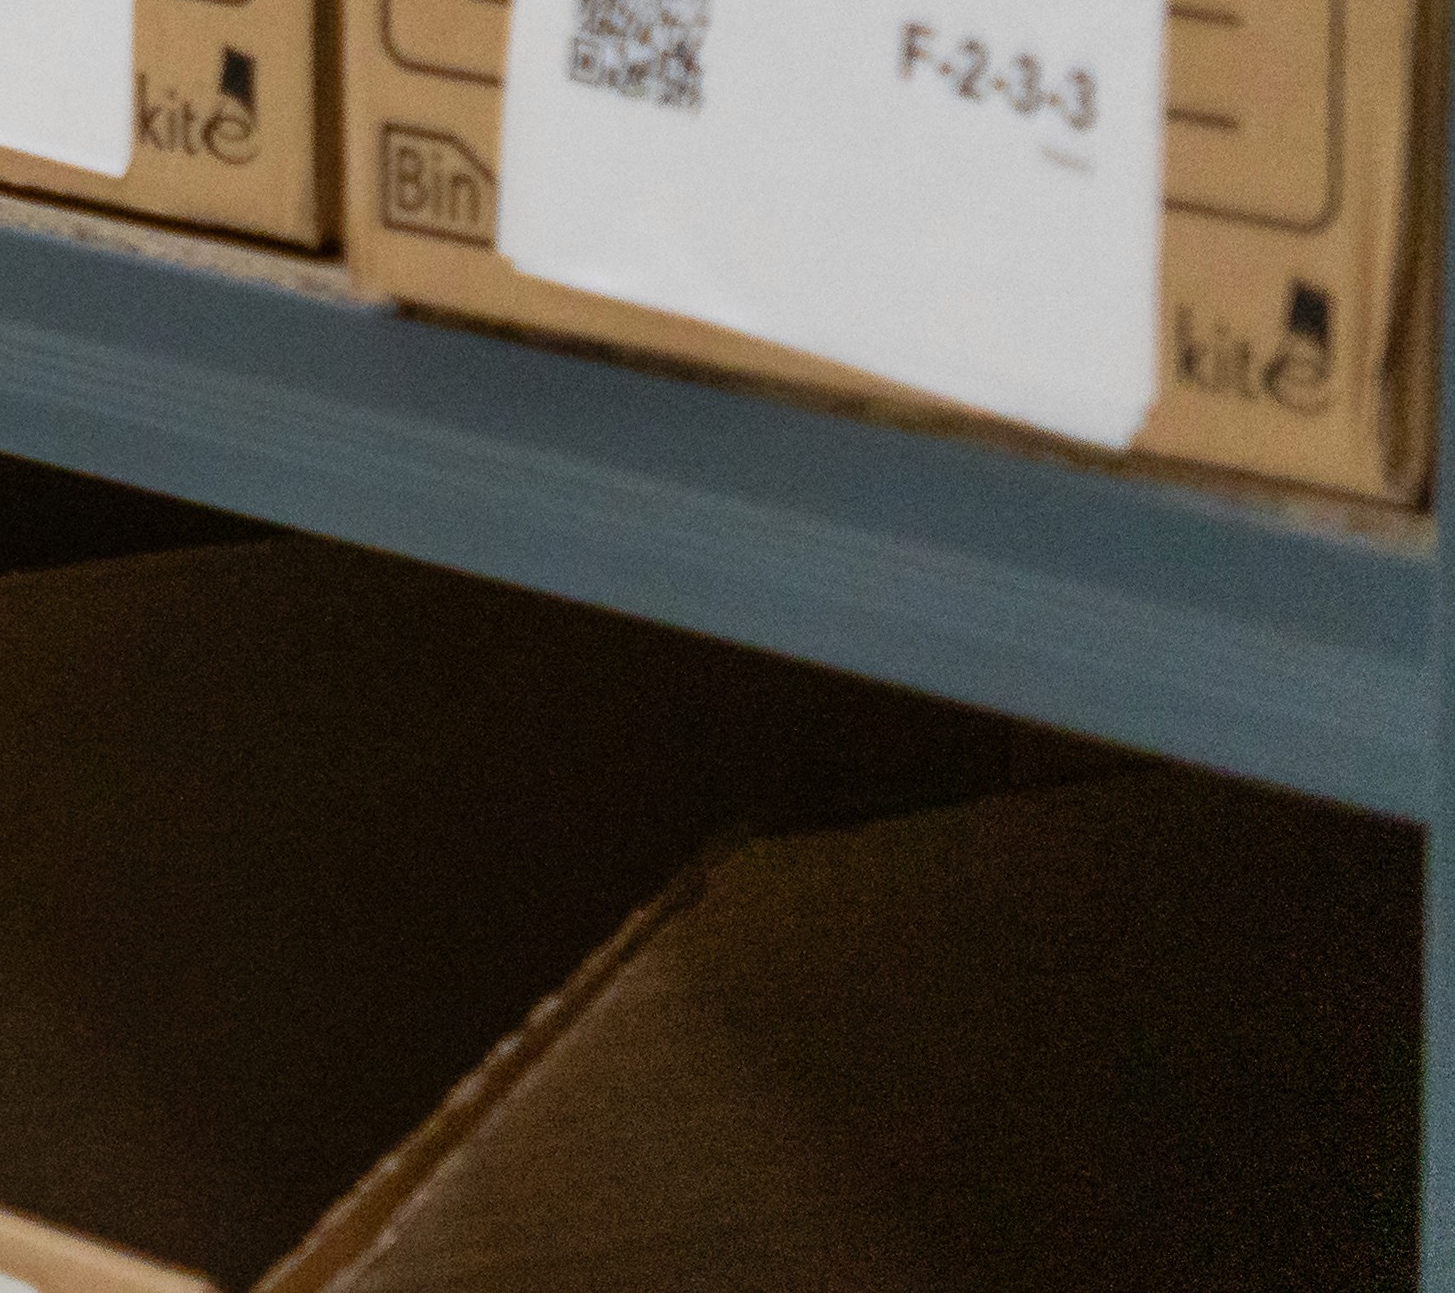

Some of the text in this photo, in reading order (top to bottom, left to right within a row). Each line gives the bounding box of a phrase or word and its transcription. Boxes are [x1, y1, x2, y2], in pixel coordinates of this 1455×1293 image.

[136, 73, 257, 164] kite
[897, 22, 1099, 131] F-2-3-3
[392, 147, 482, 225] Bin
[1173, 306, 1331, 414] kite
